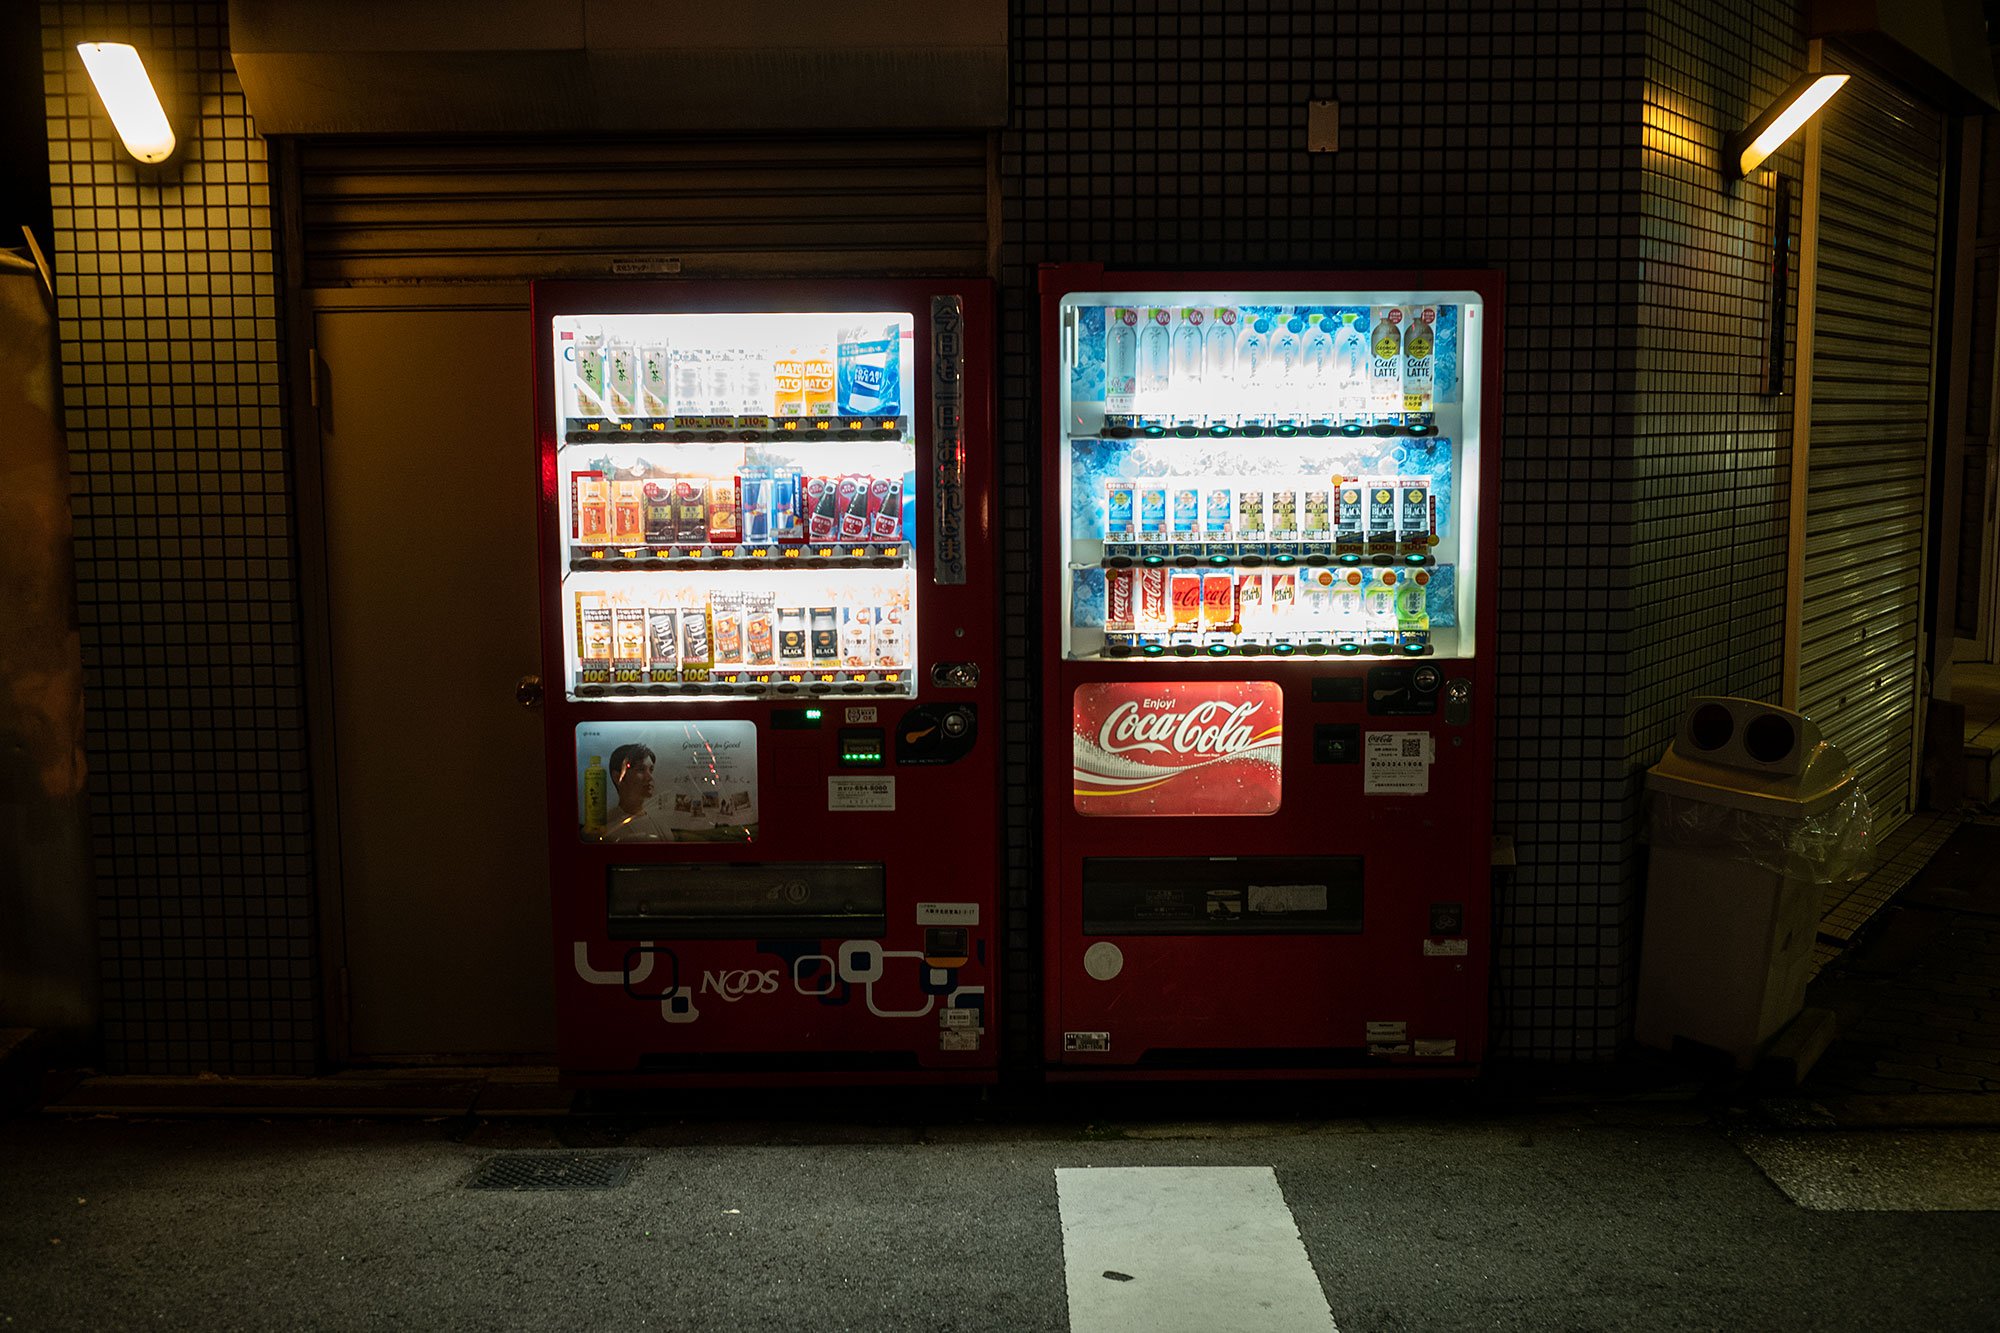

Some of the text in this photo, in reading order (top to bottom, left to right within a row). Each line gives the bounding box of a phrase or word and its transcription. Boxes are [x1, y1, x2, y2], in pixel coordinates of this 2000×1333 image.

[1374, 358, 1397, 368] Café
[1407, 358, 1430, 368] Café
[1374, 368, 1397, 377] LATTE
[1407, 368, 1430, 377] LATTE
[1340, 507, 1361, 516] BLACK
[1372, 507, 1393, 516] BLACK
[1404, 507, 1425, 516] BLACK
[1143, 699, 1175, 711] Enjoy!
[1099, 700, 1264, 755] Coca-Cola
[723, 741, 742, 751] Good
